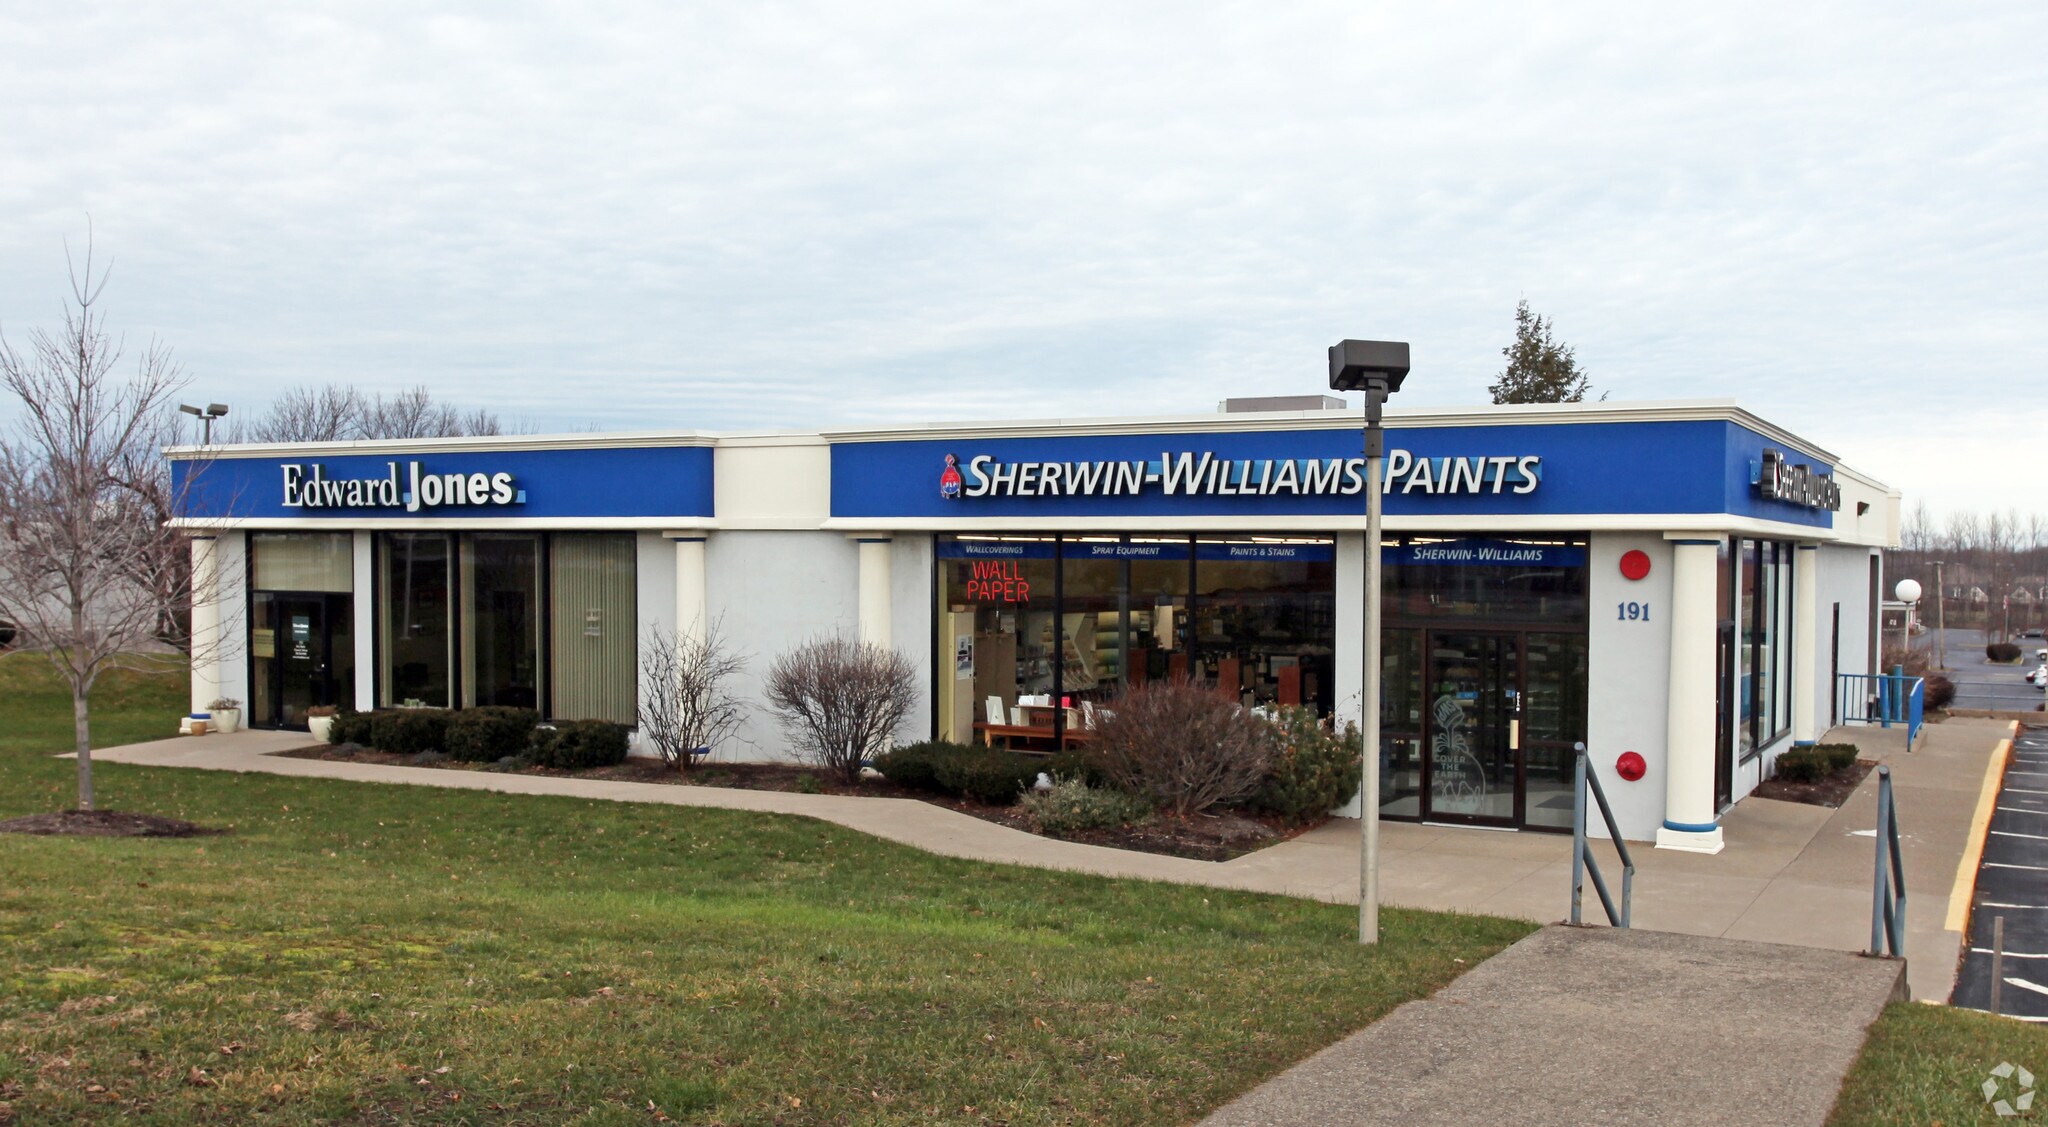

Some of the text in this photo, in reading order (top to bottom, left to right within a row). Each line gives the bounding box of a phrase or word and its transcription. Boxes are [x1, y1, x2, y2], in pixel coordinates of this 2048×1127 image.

[966, 449, 1540, 496] SHERWIN-WILLIAMS PAINTS
[281, 461, 513, 512] Edward Jones
[965, 545, 1024, 554] WALLCOVERINGS
[1092, 544, 1160, 556] SPRAY EQUIPMENT
[1230, 547, 1296, 557] PAINTS & STAINS
[1413, 547, 1543, 561] SHERWIN-WILLIAMS
[971, 560, 1025, 581] WALL
[967, 580, 1031, 602] PAPER
[1617, 602, 1650, 621] 191
[1433, 754, 1466, 764] COVER
[1440, 763, 1459, 771] THE
[1434, 770, 1466, 779] EARTH
